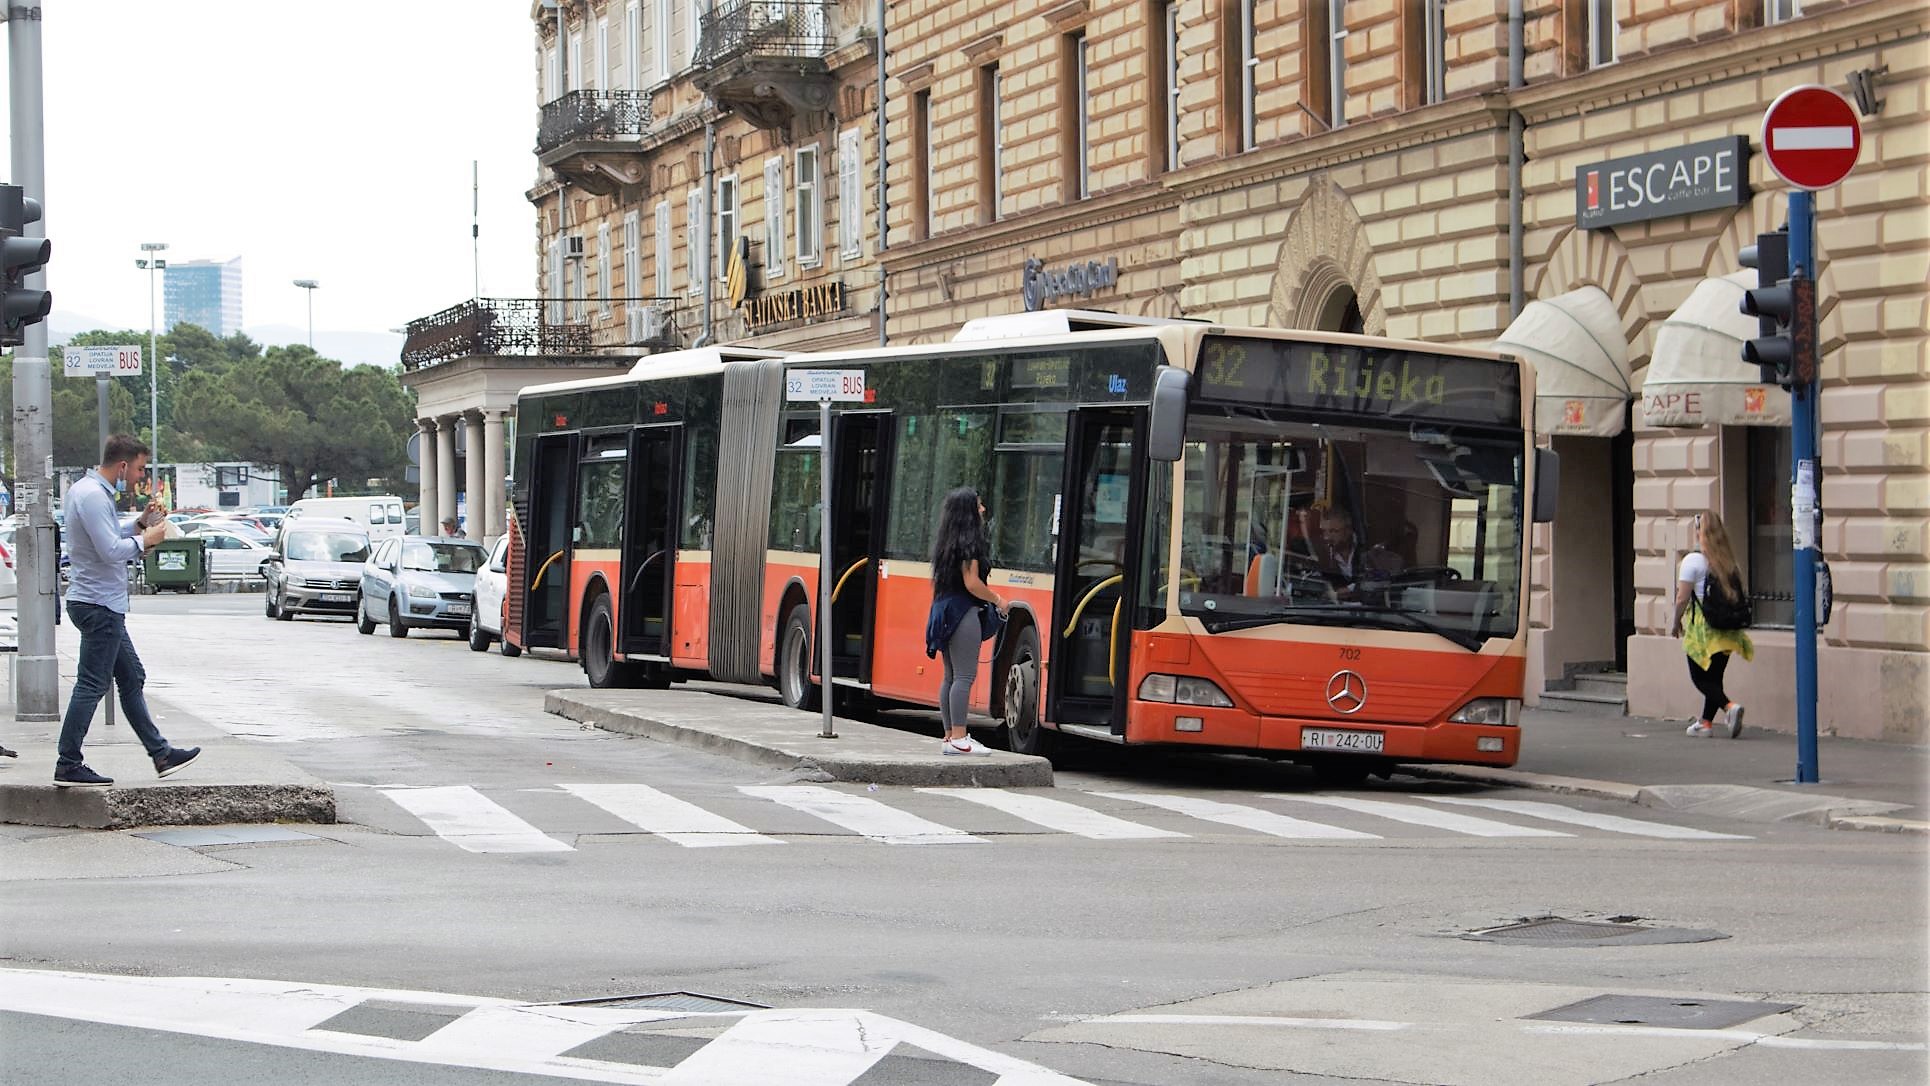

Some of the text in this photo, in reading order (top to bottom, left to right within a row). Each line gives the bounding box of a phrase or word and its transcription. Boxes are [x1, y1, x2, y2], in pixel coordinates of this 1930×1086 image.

[1610, 150, 1732, 210] ESCAPE
[802, 281, 843, 318] BANKA
[66, 355, 81, 368] 32
[120, 351, 139, 369] BUS
[1205, 343, 1445, 404] 32 Rijeka
[787, 381, 802, 393] 32
[843, 376, 863, 394] BUS
[1108, 374, 1127, 393] Ulaz
[1339, 647, 1361, 661] 702
[1311, 732, 1325, 745] RI
